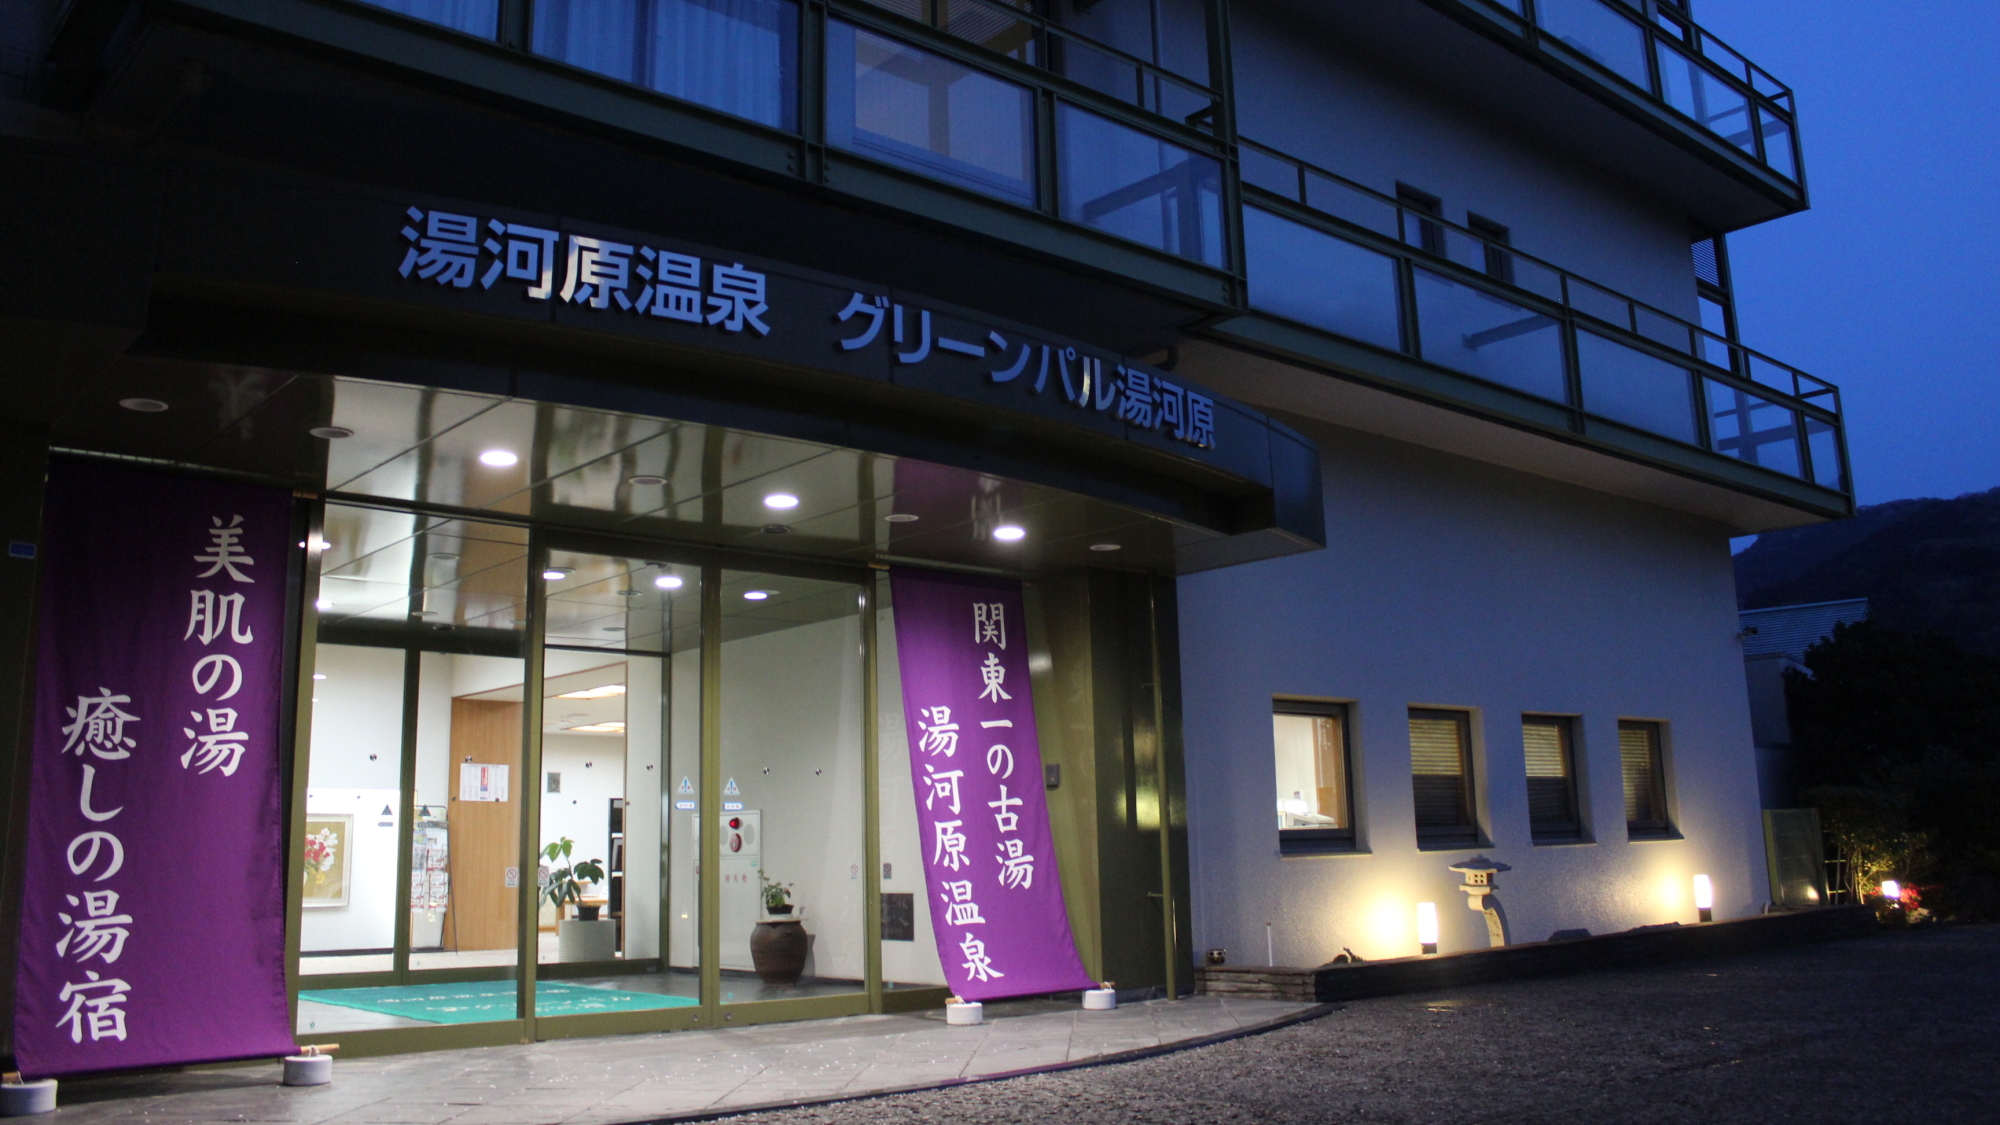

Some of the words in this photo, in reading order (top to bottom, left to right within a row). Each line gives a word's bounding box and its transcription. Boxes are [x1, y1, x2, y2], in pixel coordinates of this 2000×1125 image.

[397, 205, 770, 337] 湯河原温泉
[837, 291, 1215, 450] グリーンパル湯河原
[180, 513, 255, 776] 美肌の湯
[972, 602, 1035, 890] 関東一の古湯
[55, 685, 141, 1043] 癒しの湯宿
[917, 705, 1005, 982] 湯河原温泉
